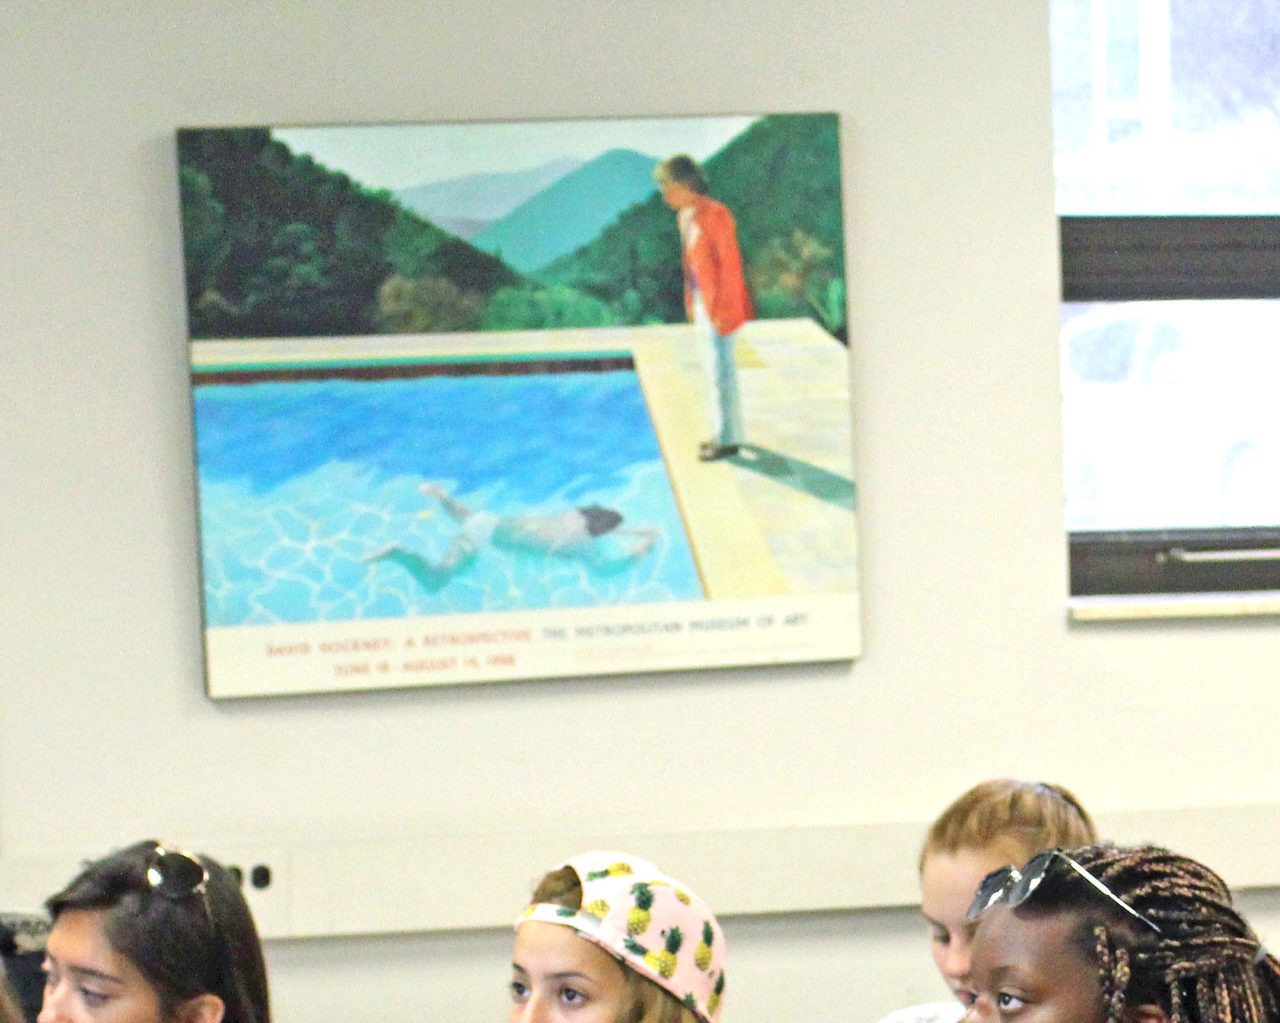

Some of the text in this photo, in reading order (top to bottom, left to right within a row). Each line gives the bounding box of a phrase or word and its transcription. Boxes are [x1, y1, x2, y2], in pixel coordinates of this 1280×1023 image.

[266, 642, 311, 657] DAVID
[404, 636, 416, 648] A
[422, 628, 532, 647] RETROSPECTIVE
[542, 626, 567, 639] THE
[574, 619, 684, 639] METROPOLITAN
[688, 616, 750, 632] MUSEUM
[755, 614, 775, 629] OF
[782, 612, 809, 626] ART
[334, 662, 371, 676] JUNE
[401, 656, 457, 672] AUGUST
